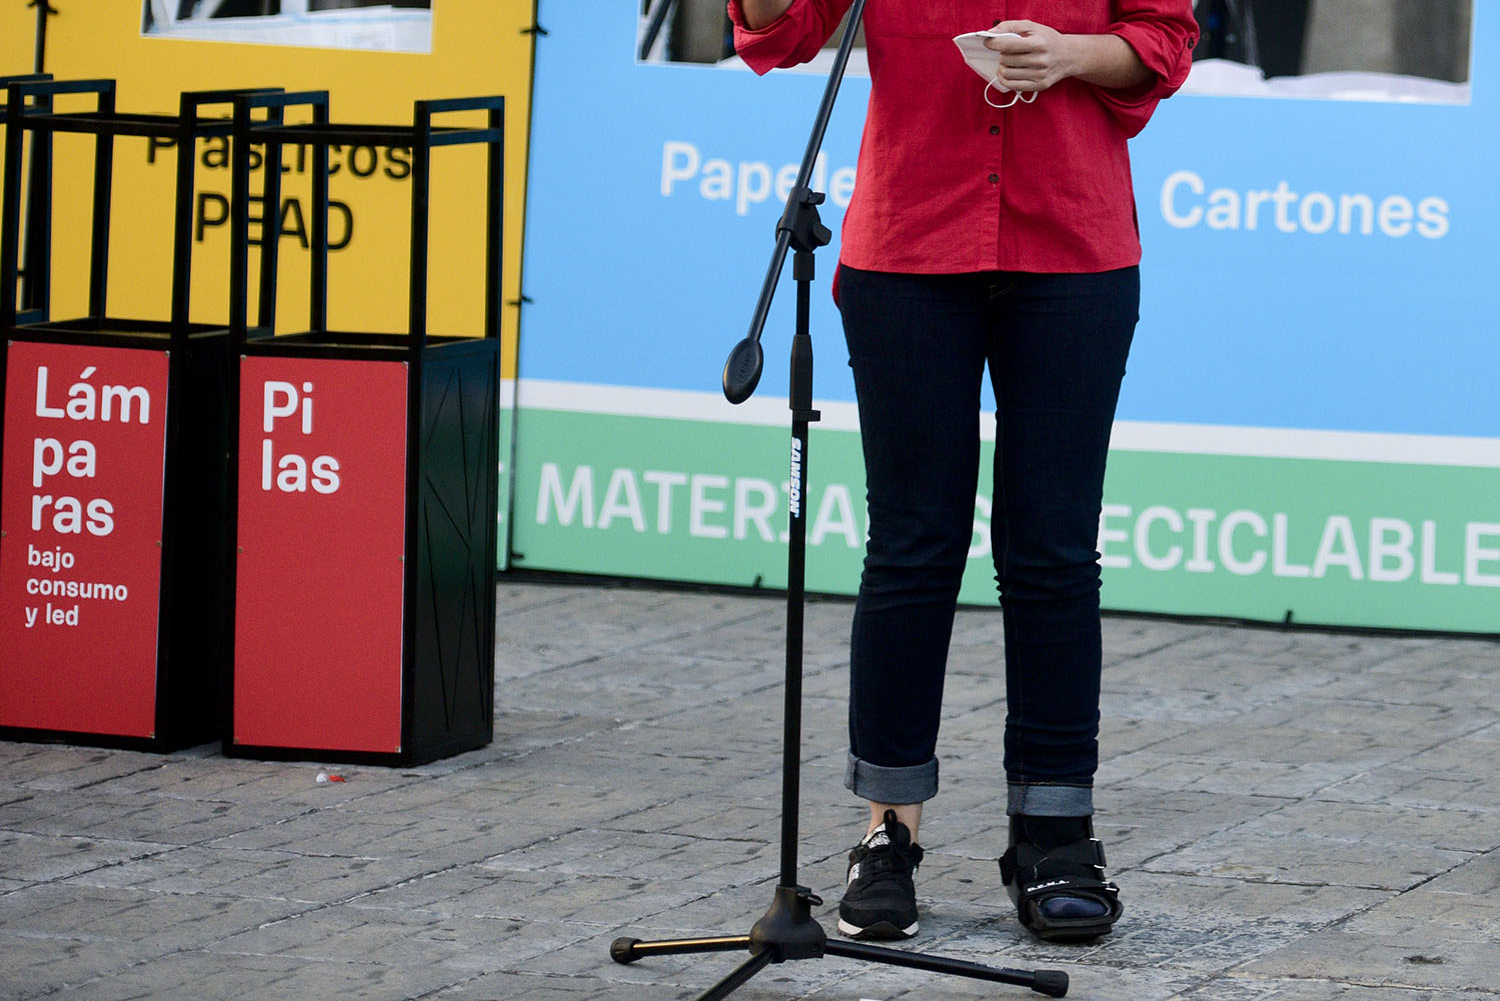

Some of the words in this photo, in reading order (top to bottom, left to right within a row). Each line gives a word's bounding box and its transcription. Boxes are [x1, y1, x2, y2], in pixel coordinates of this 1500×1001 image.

[1160, 170, 1450, 240] Cartones
[35, 366, 150, 424] Lám
[263, 380, 313, 434] Pi
[32, 437, 97, 488] pa
[262, 439, 341, 495] las
[789, 436, 802, 516] SAMSON
[31, 494, 115, 536] ras
[27, 544, 75, 573] bajo
[24, 605, 38, 628] y
[45, 603, 79, 626] led
[26, 578, 128, 601] consumo
